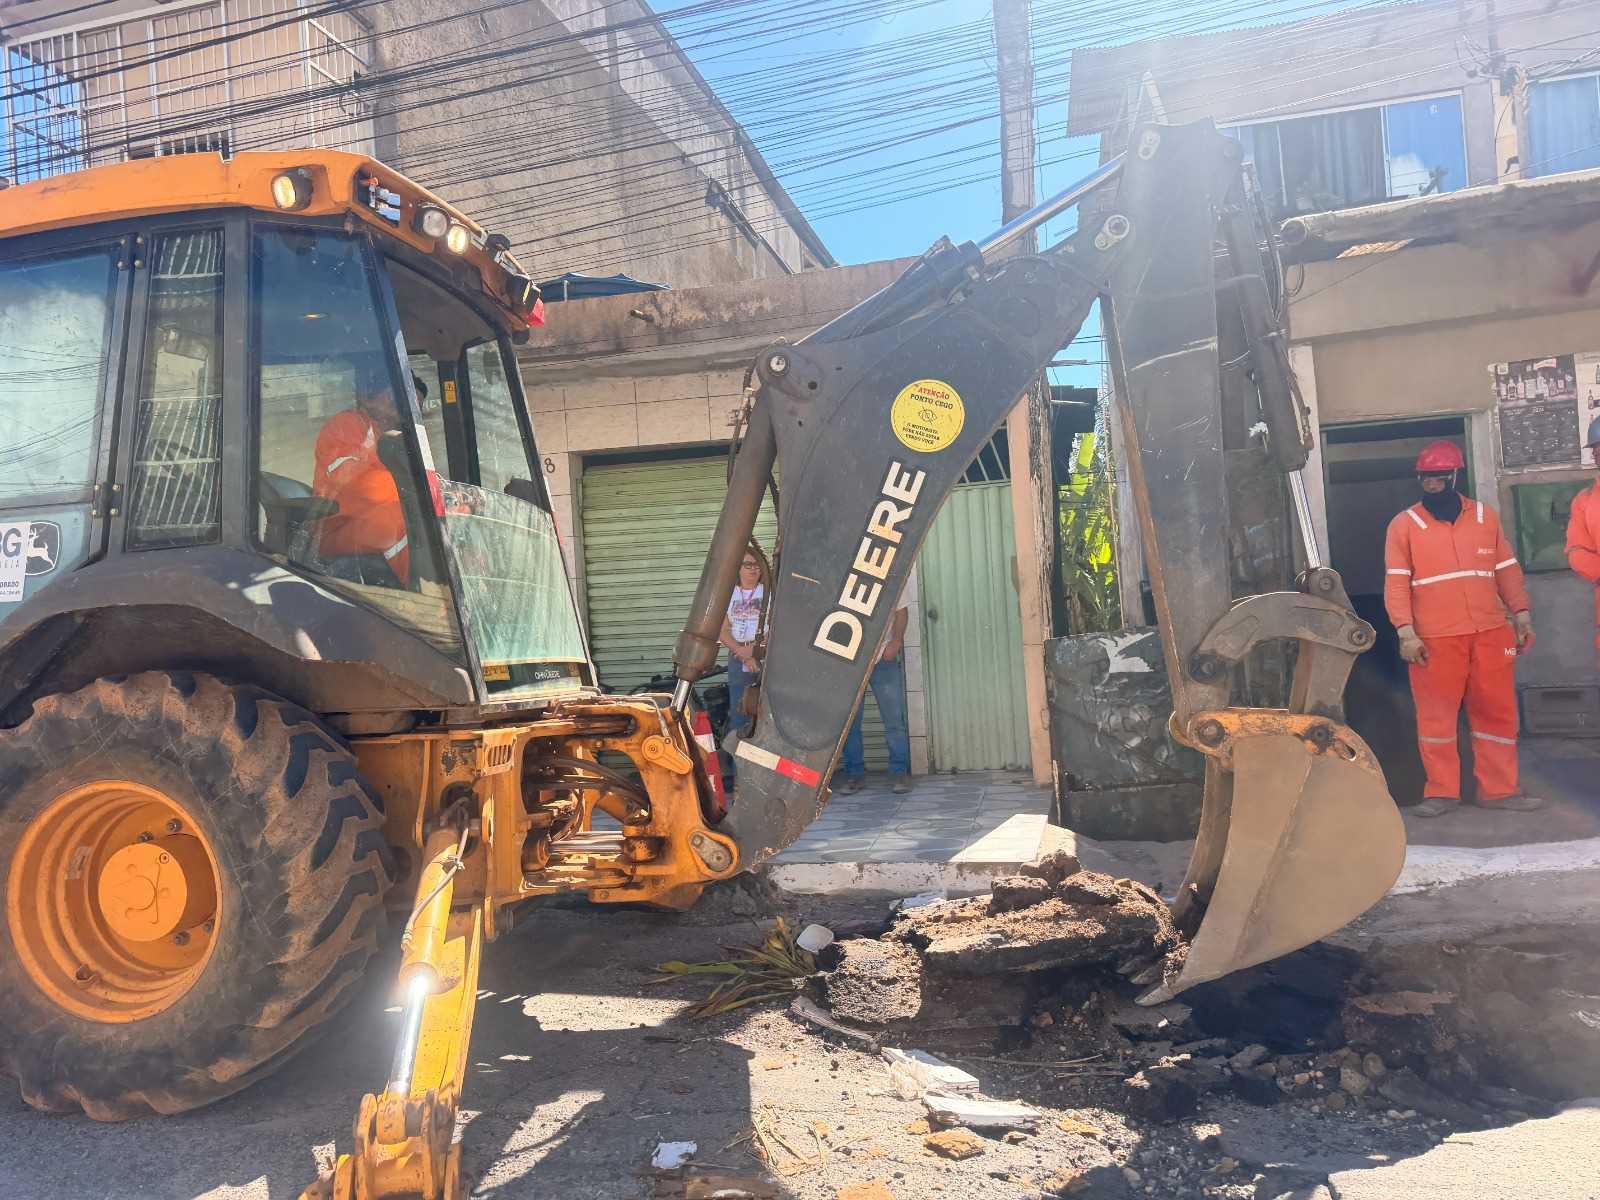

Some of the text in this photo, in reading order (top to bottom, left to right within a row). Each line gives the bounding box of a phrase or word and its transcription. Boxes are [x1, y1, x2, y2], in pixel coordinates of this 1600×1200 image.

[910, 393, 954, 410] PONTO CEGO
[917, 386, 950, 400] ATENÇÃO
[544, 458, 556, 473] 8
[0, 528, 22, 558] G
[813, 461, 926, 660] DEERE
